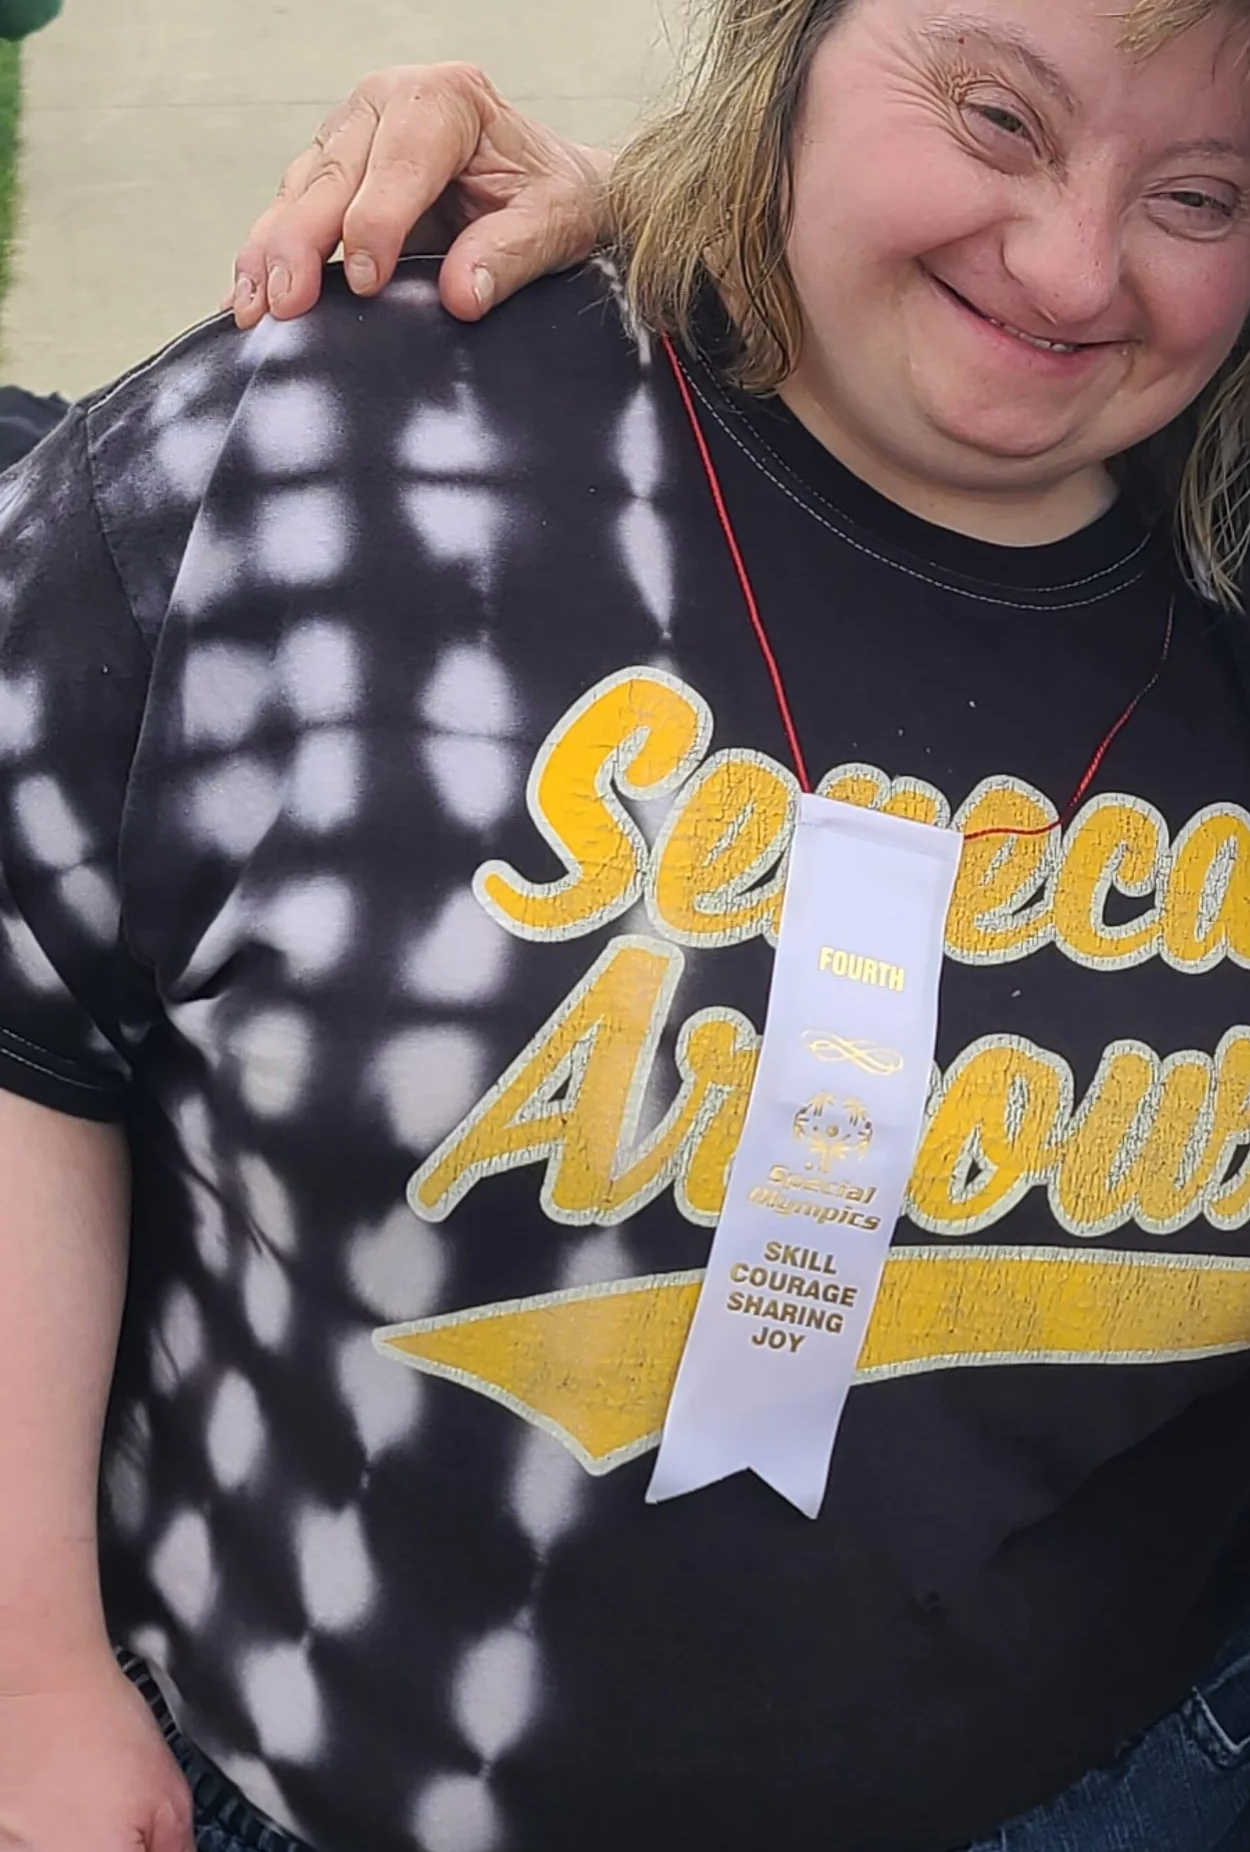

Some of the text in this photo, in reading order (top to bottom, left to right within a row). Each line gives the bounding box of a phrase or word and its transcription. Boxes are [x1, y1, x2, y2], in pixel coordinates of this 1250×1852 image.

[818, 945, 905, 992] FOURTH
[767, 1164, 877, 1204] Special
[748, 1185, 881, 1230] Olympics
[763, 1241, 838, 1275] SKILL
[729, 1262, 858, 1308] COURAGE
[726, 1291, 844, 1333] SHARING
[751, 1326, 807, 1354] JOY
